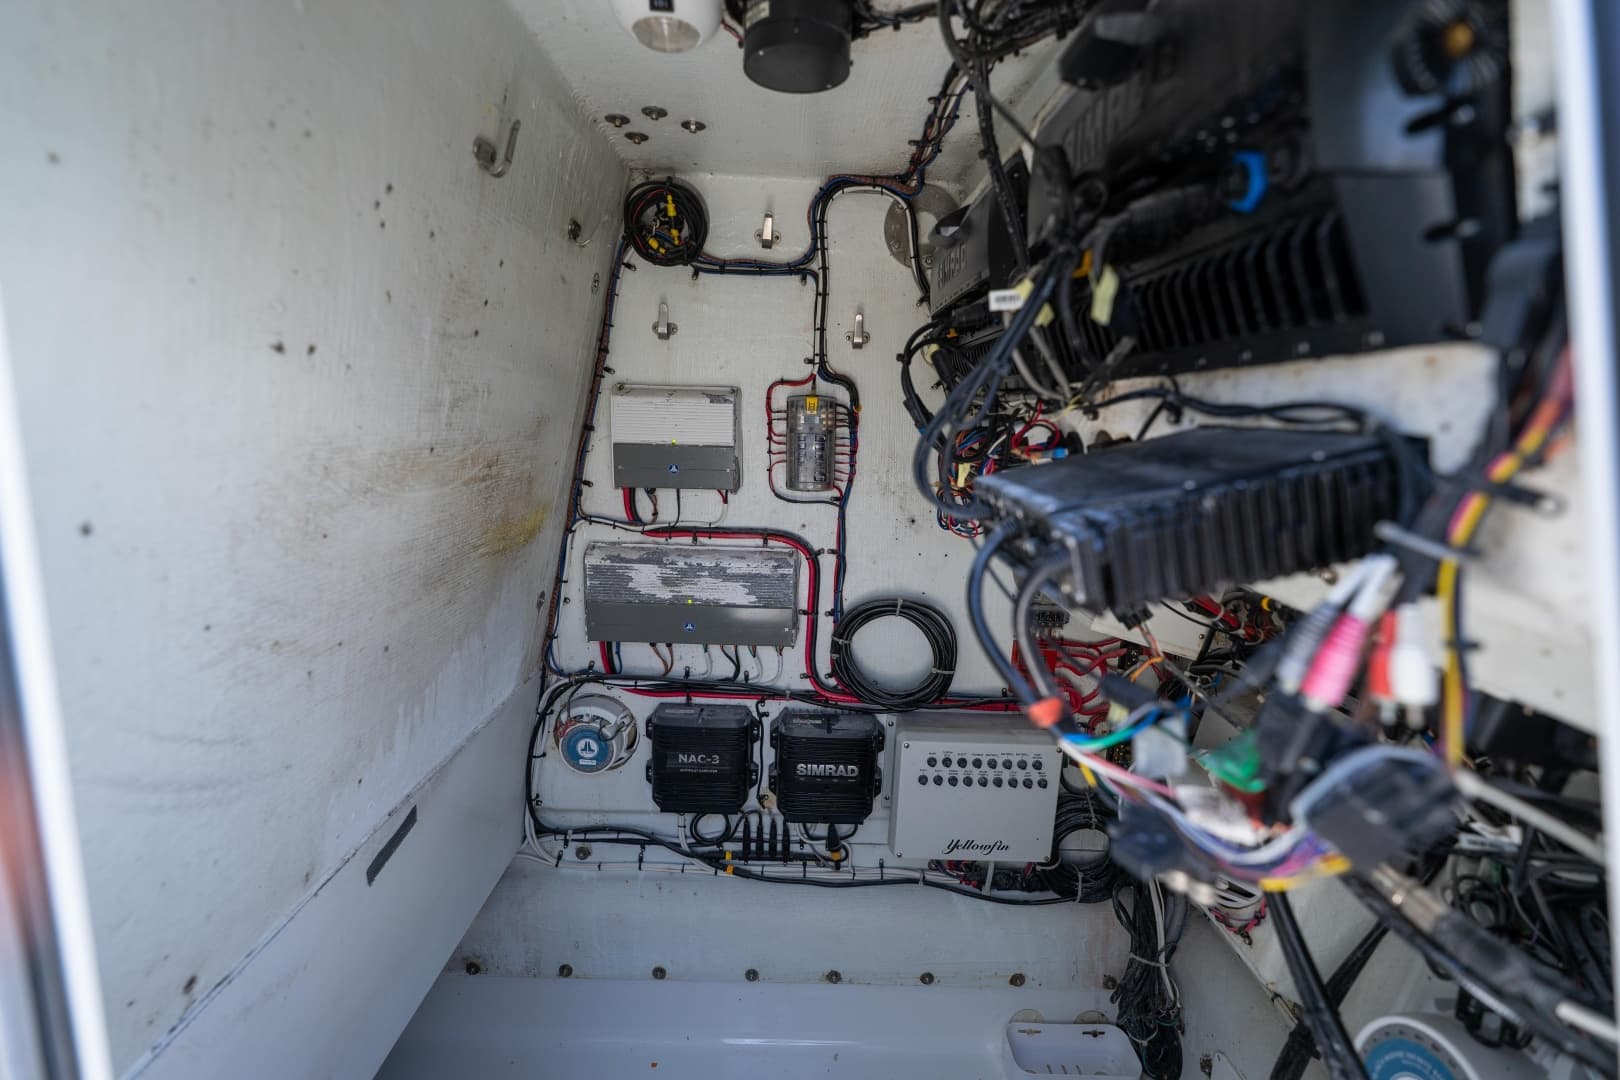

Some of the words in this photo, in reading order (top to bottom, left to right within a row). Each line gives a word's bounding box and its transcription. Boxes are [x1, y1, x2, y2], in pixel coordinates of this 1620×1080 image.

[678, 753, 720, 764] NAC-3
[796, 763, 859, 777] SIMRAD
[942, 838, 1010, 856] Yellowfin
